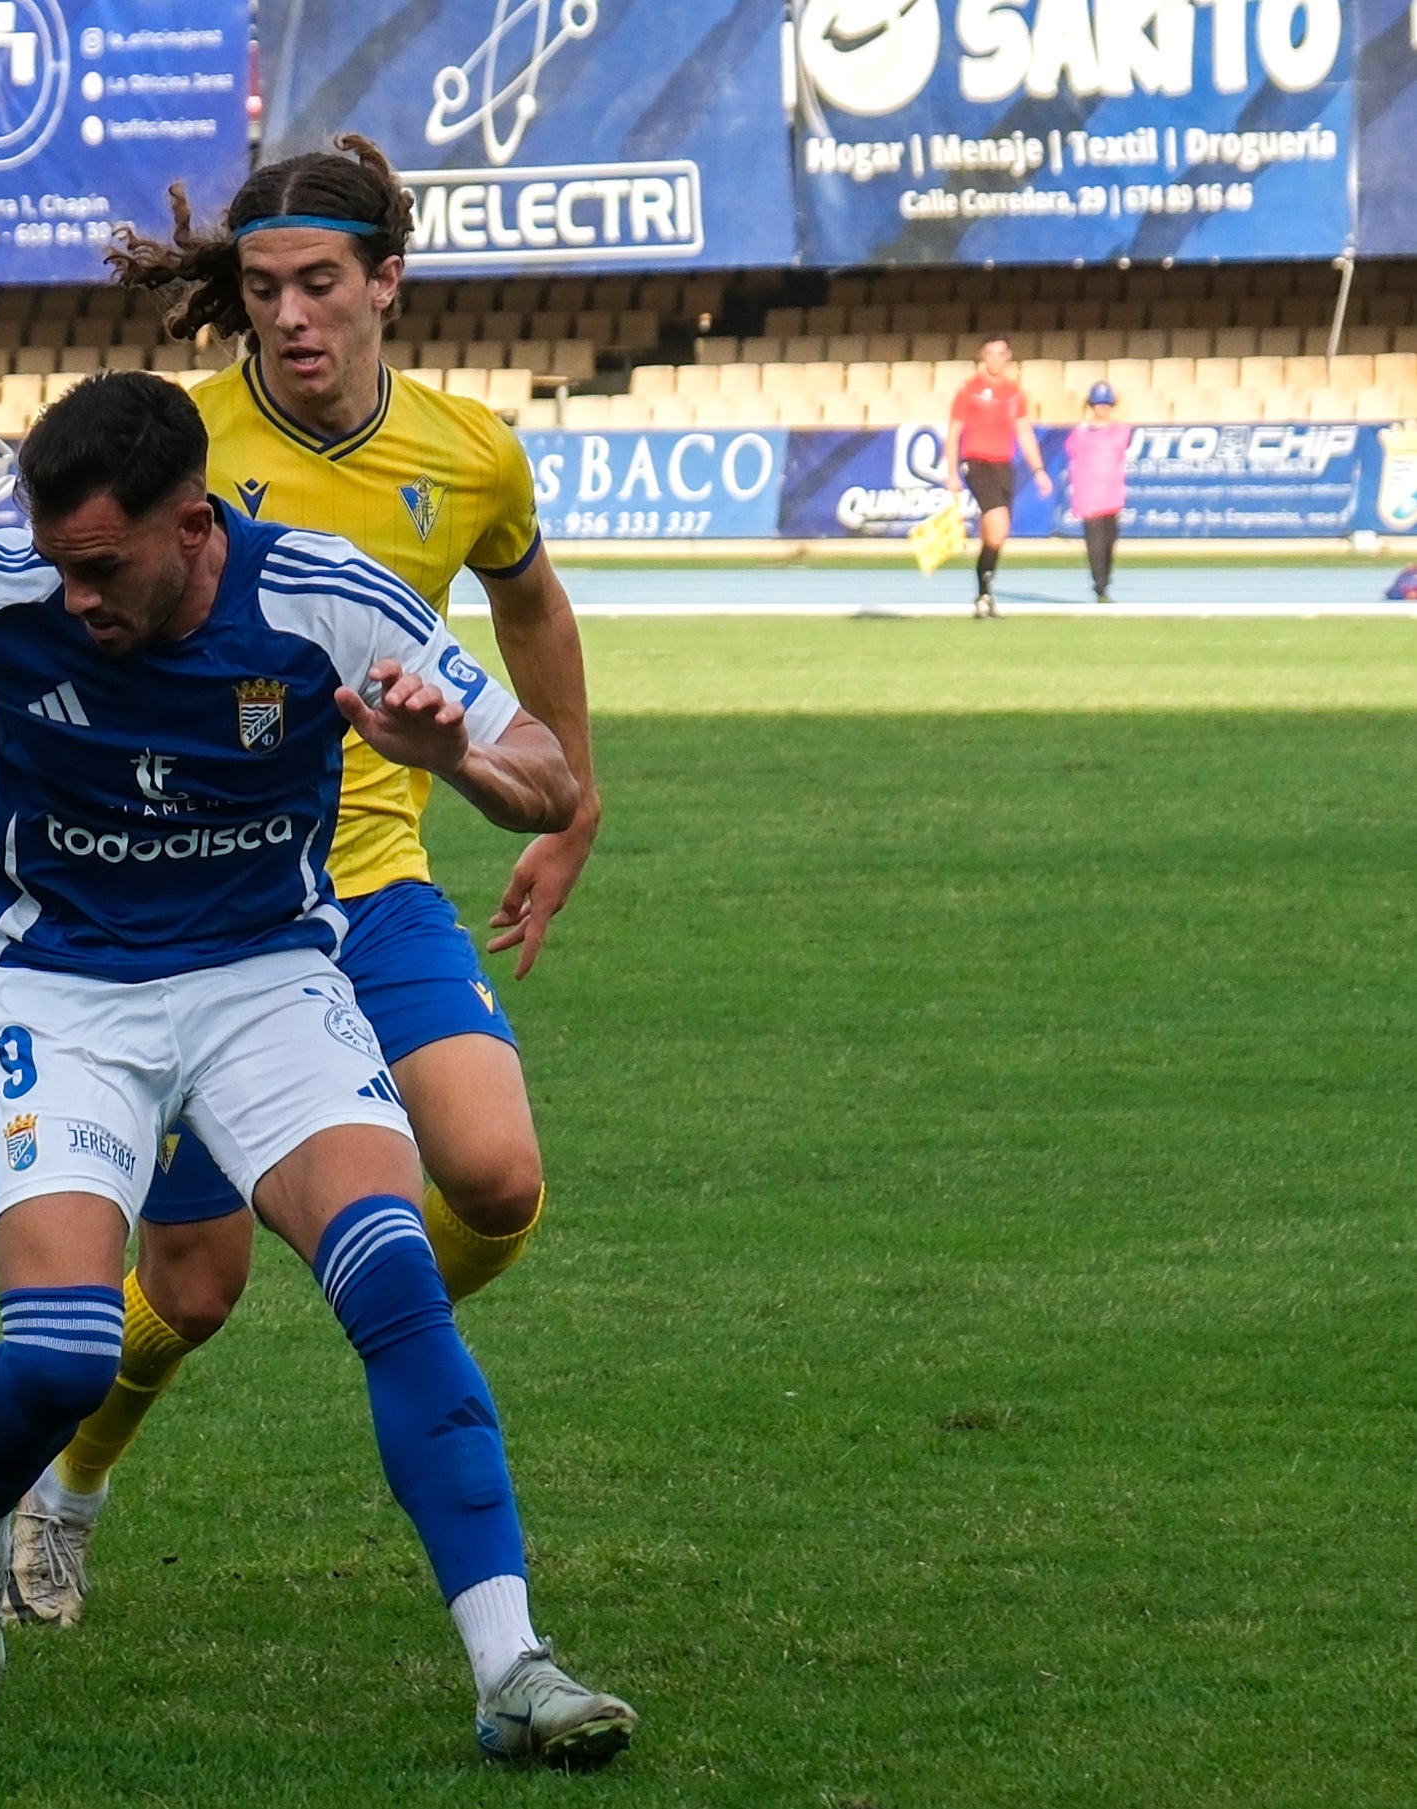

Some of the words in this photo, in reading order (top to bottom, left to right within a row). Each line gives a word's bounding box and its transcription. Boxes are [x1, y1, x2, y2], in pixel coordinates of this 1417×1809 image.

[806, 137, 904, 182] Hogar
[929, 130, 1043, 178] Menaje
[1067, 126, 1159, 168] Textil
[1184, 122, 1337, 173] Droguería
[402, 177, 691, 249] MELECTRI
[899, 187, 958, 220] Calle
[577, 432, 774, 502] BACO
[564, 510, 610, 538] 956
[614, 510, 660, 538] 333
